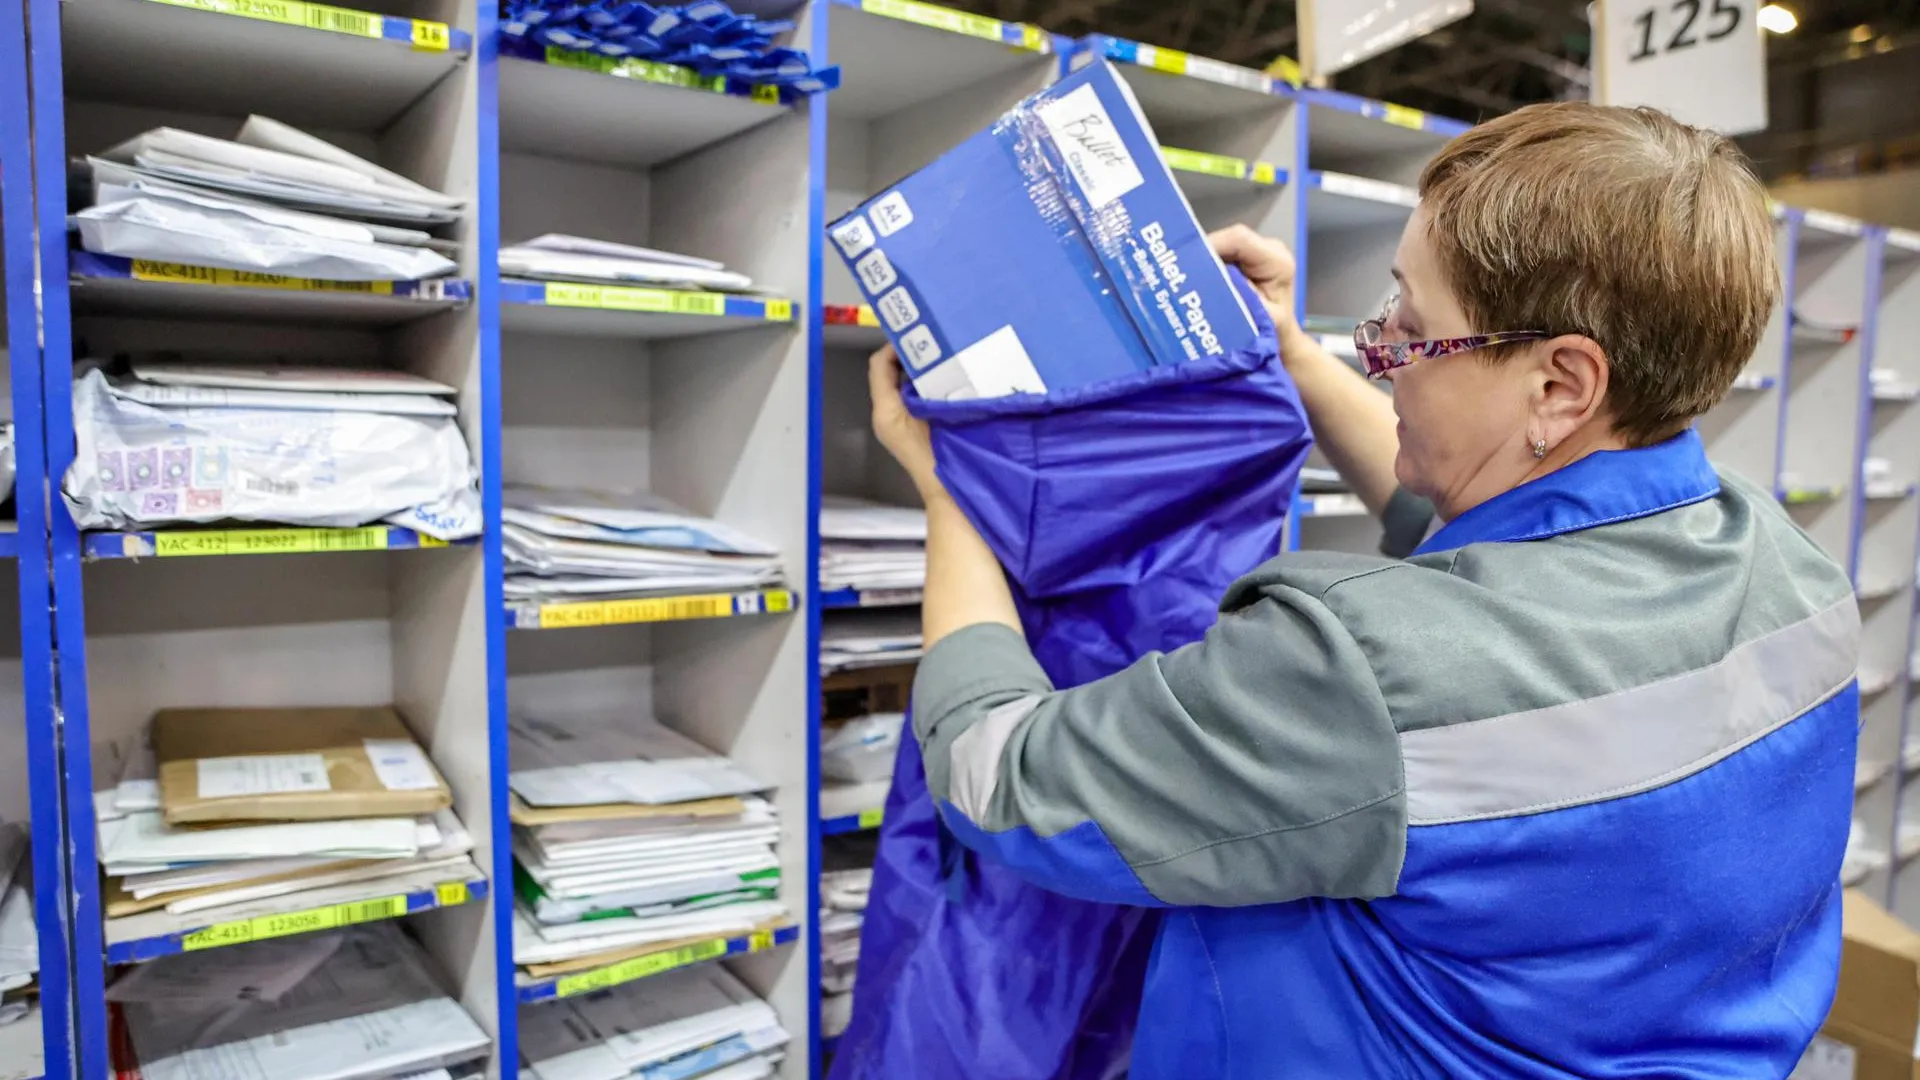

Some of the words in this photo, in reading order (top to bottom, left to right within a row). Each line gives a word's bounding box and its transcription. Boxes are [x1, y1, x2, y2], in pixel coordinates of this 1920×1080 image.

[1629, 0, 1742, 62] 125
[1062, 113, 1128, 168] Ballet
[882, 203, 903, 224] A4
[890, 292, 913, 323] 2500
[1140, 221, 1188, 293] Ballet.
[1178, 290, 1224, 356] Paper
[1154, 288, 1187, 338] Бумага
